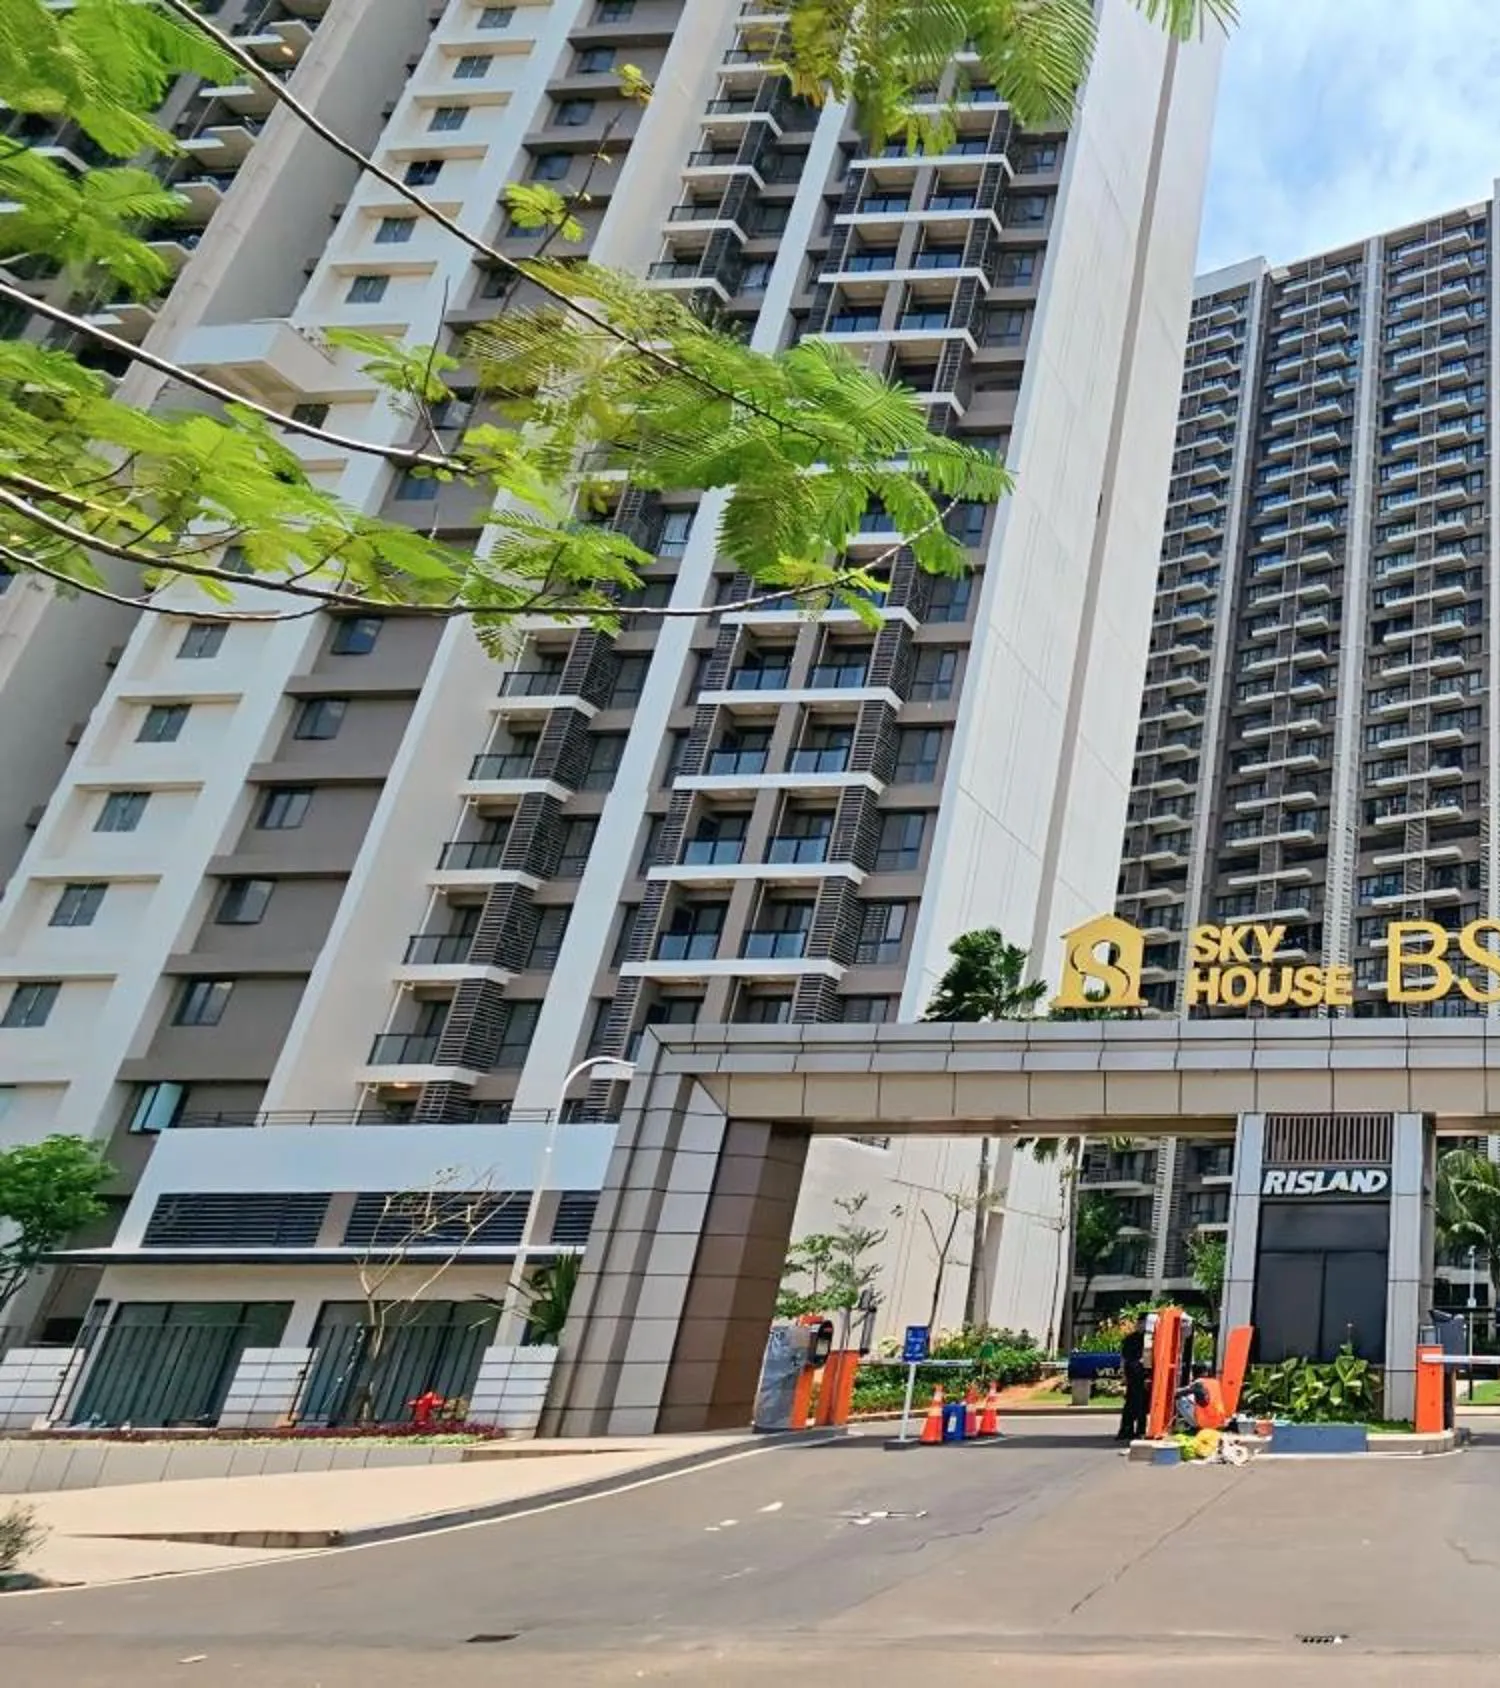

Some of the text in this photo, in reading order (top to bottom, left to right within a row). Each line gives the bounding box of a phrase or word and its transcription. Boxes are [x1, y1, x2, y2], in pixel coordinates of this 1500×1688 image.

[1192, 924, 1286, 963] SKY
[1188, 966, 1353, 1006] HOUSE
[1262, 1169, 1388, 1195] RISLAND
